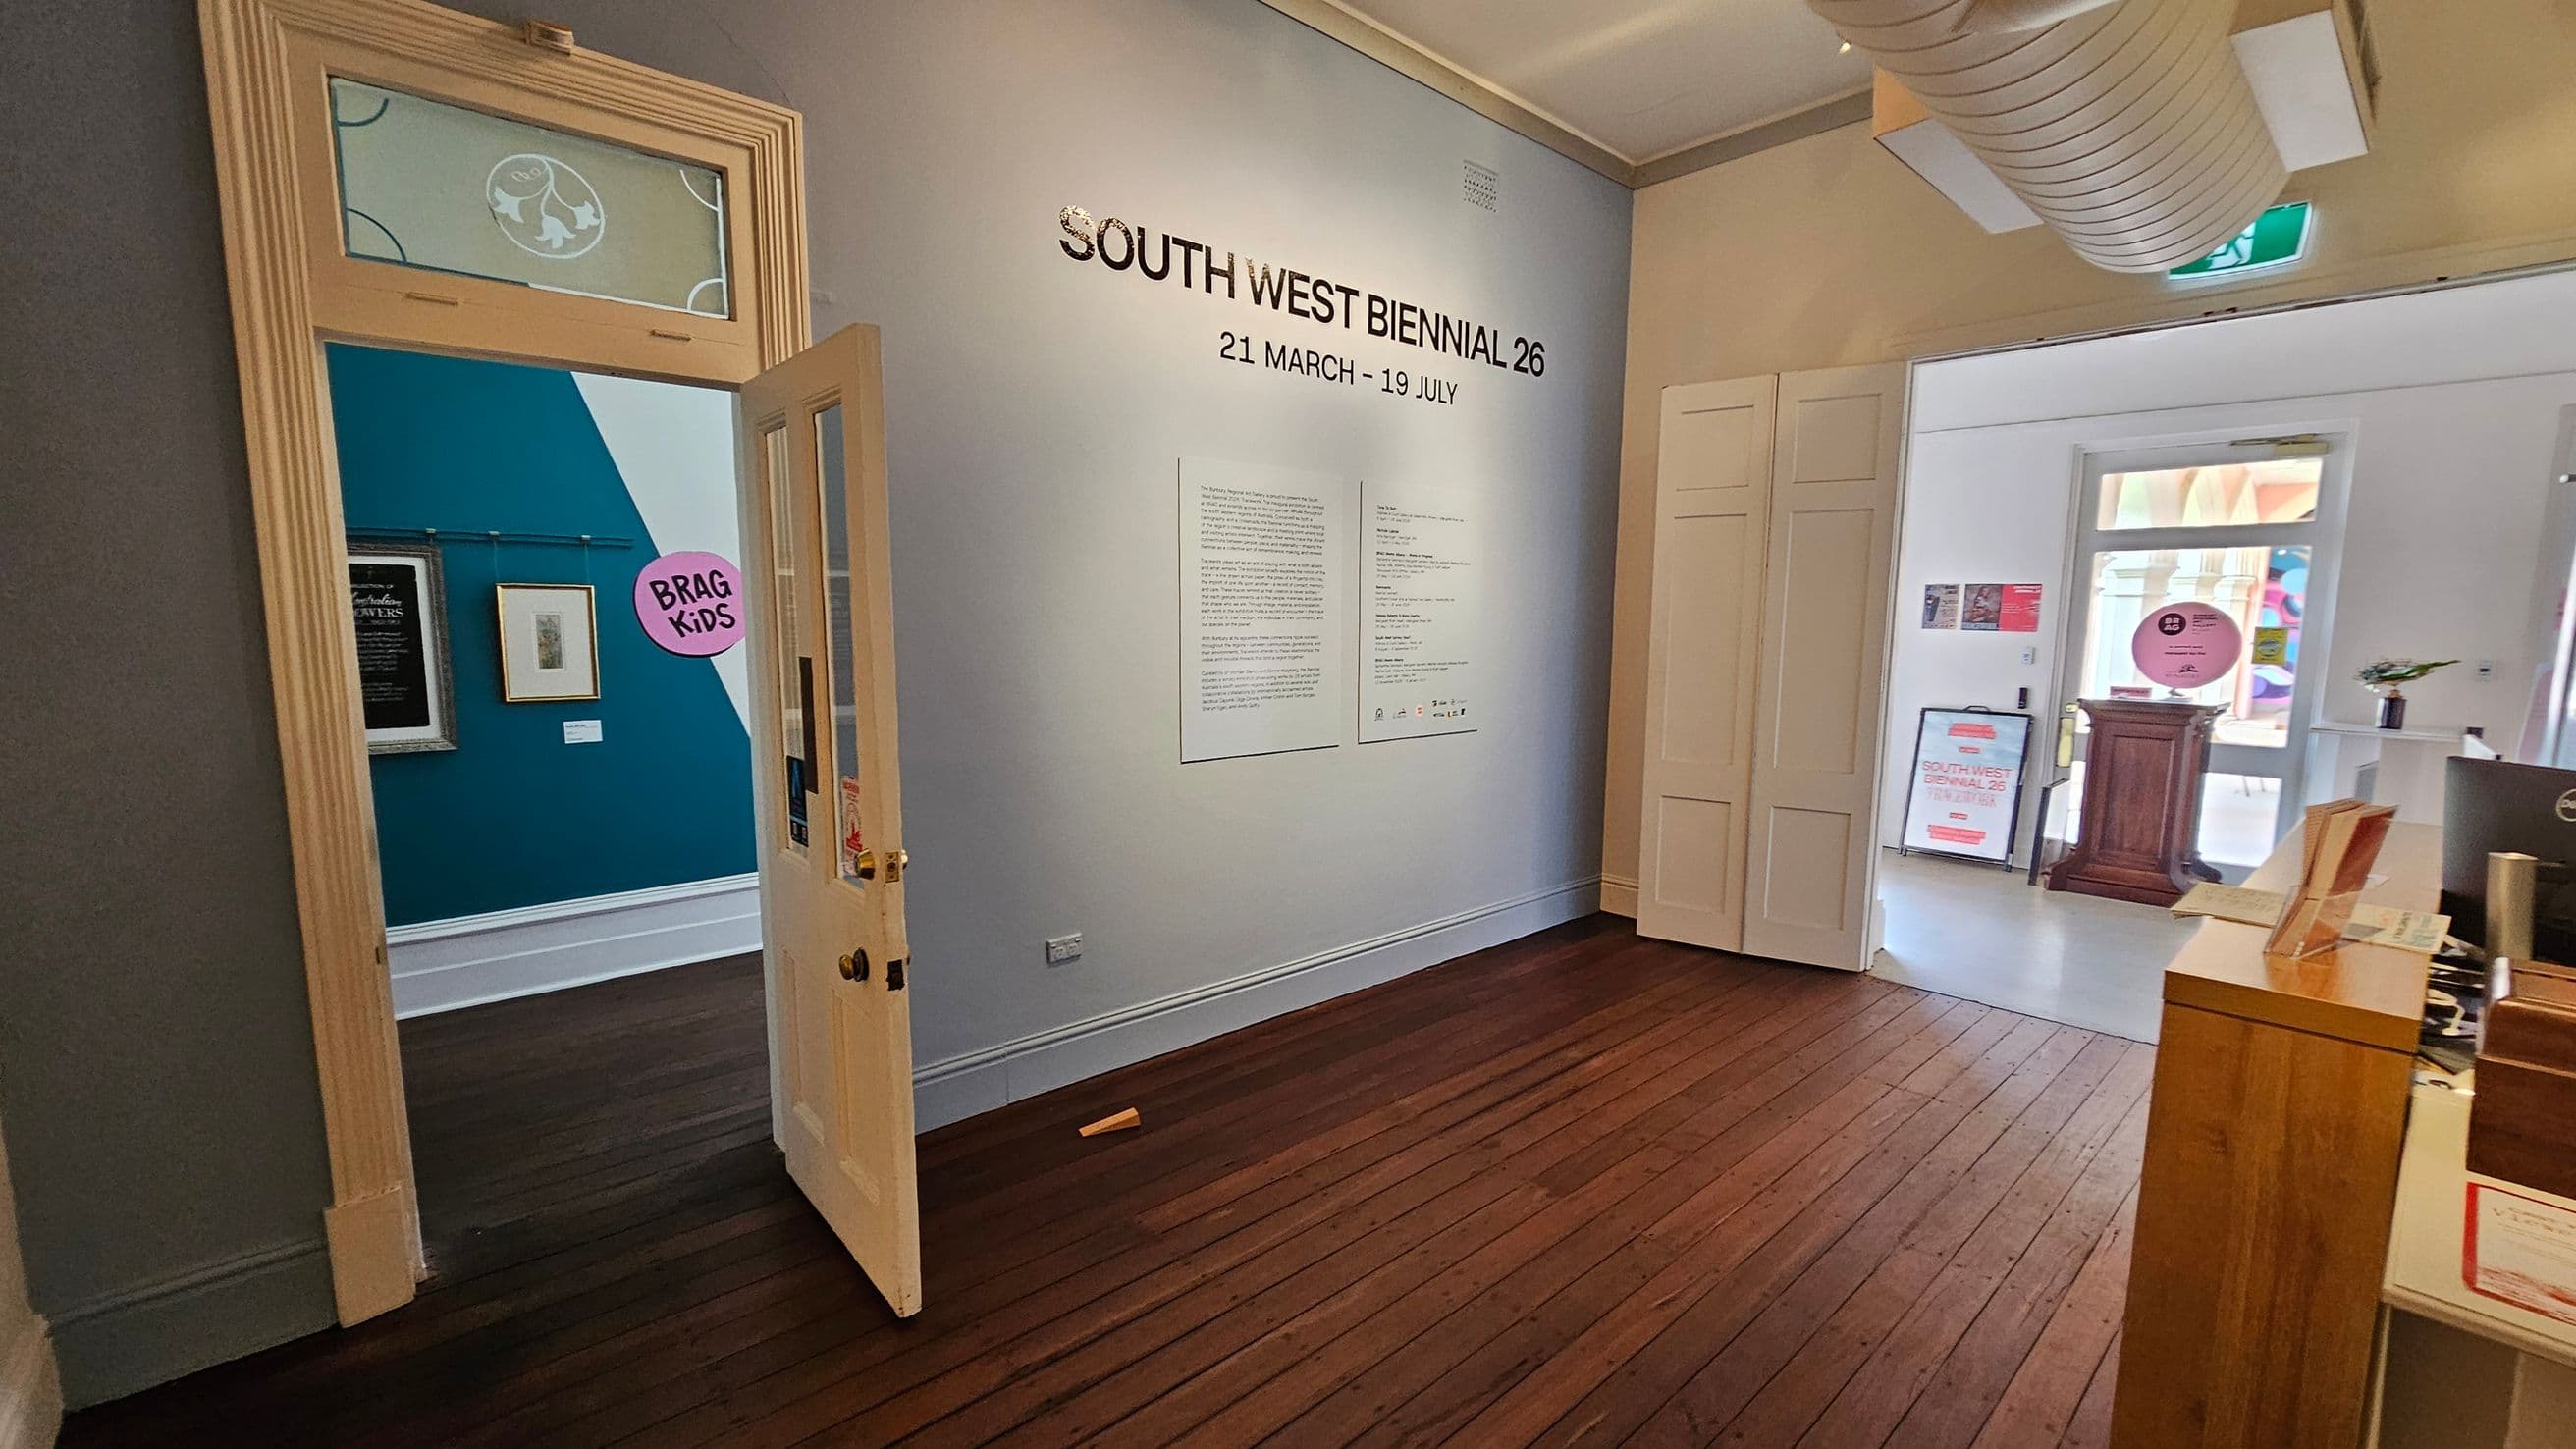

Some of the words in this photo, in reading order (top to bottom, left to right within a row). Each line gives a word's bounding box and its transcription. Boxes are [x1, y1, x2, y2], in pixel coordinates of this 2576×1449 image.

[1058, 204, 1235, 298] SOUTH
[1246, 255, 1359, 329] WEST
[1368, 294, 1508, 369] BIENNIAL
[1513, 336, 1545, 377] 26
[1219, 331, 1255, 365] 21
[1264, 341, 1354, 385] MARCH
[1381, 368, 1409, 396] 19
[1416, 376, 1458, 405] JULY
[649, 569, 732, 611] BRAG
[1922, 760, 1969, 775] SOUTH
[1971, 765, 2012, 778] WEST
[1924, 774, 1985, 789] BIENNIAL
[1988, 780, 2007, 792] 26
